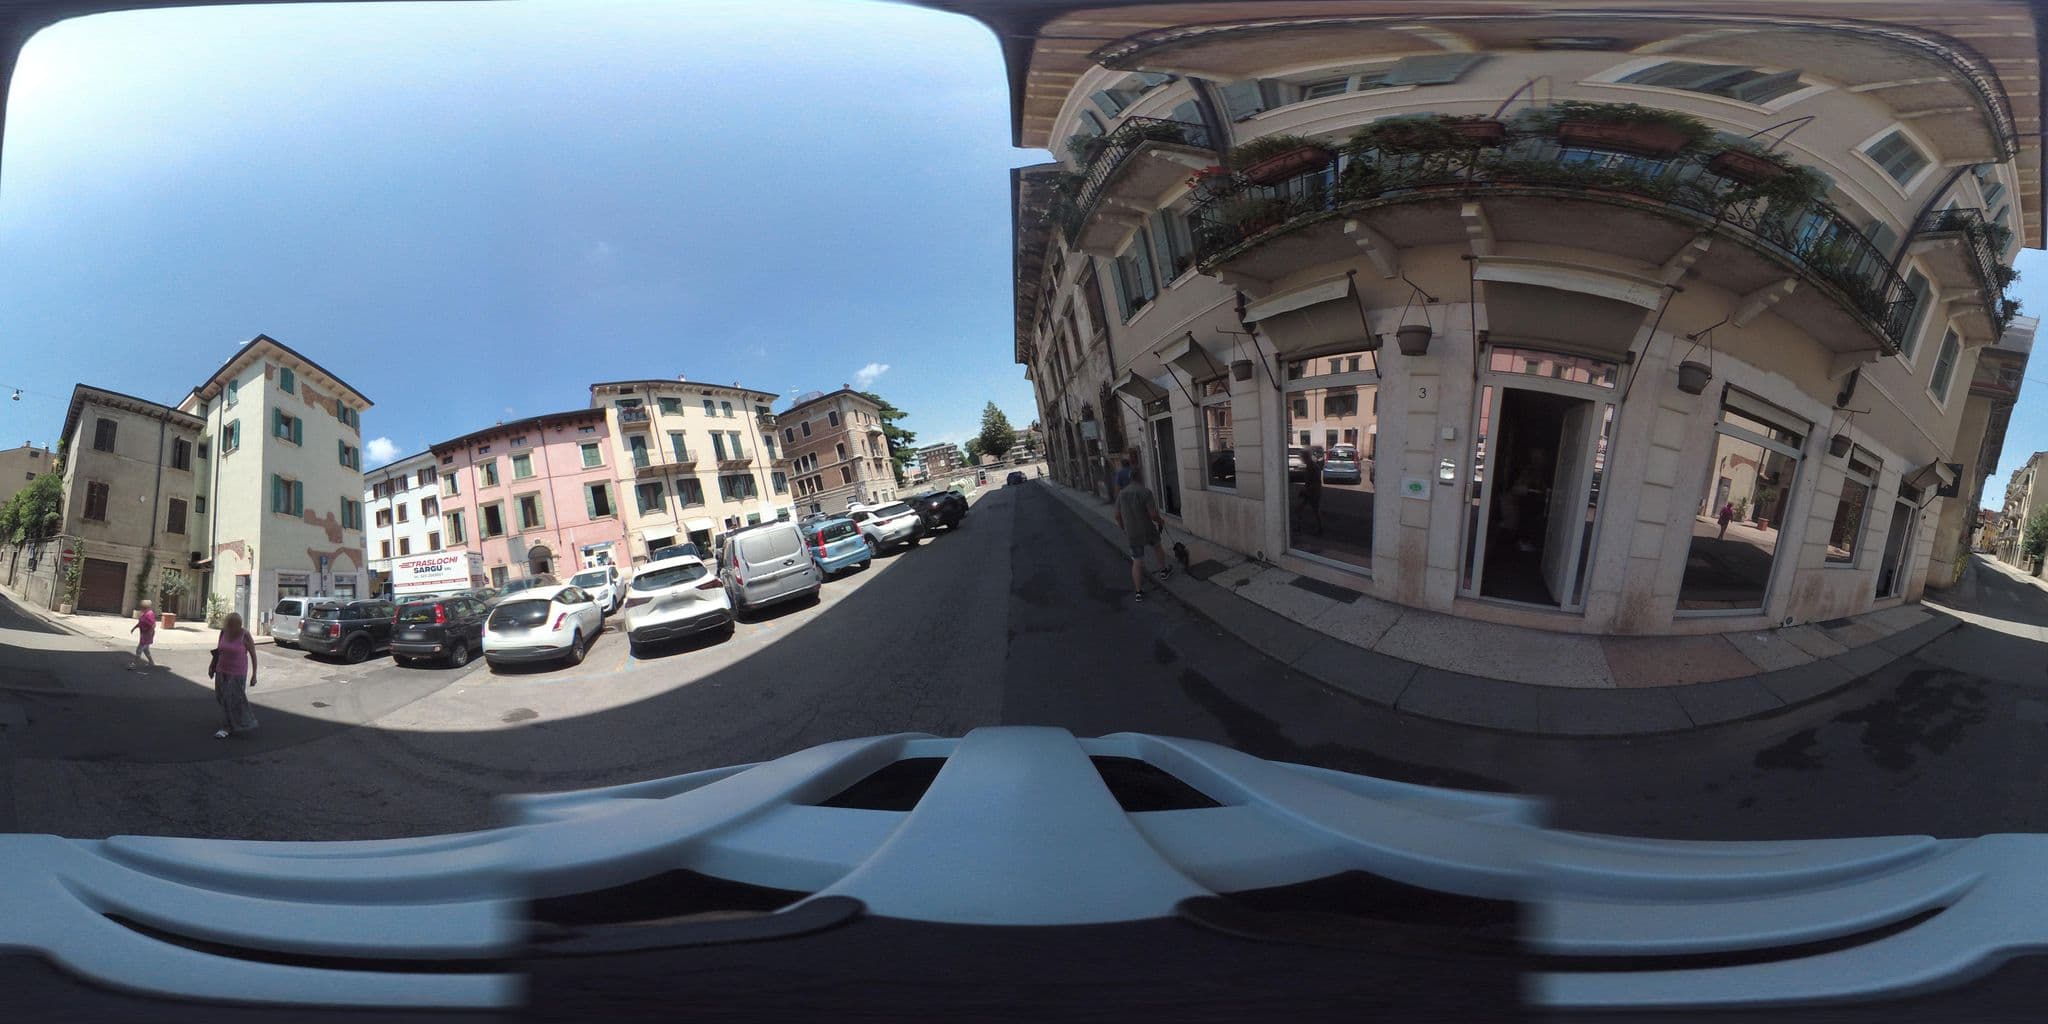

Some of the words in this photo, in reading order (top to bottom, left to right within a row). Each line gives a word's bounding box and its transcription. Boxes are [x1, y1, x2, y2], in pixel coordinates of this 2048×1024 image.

[1418, 387, 1427, 399] 3
[408, 556, 458, 567] TRASLOCHI
[413, 565, 443, 574] SARGU
